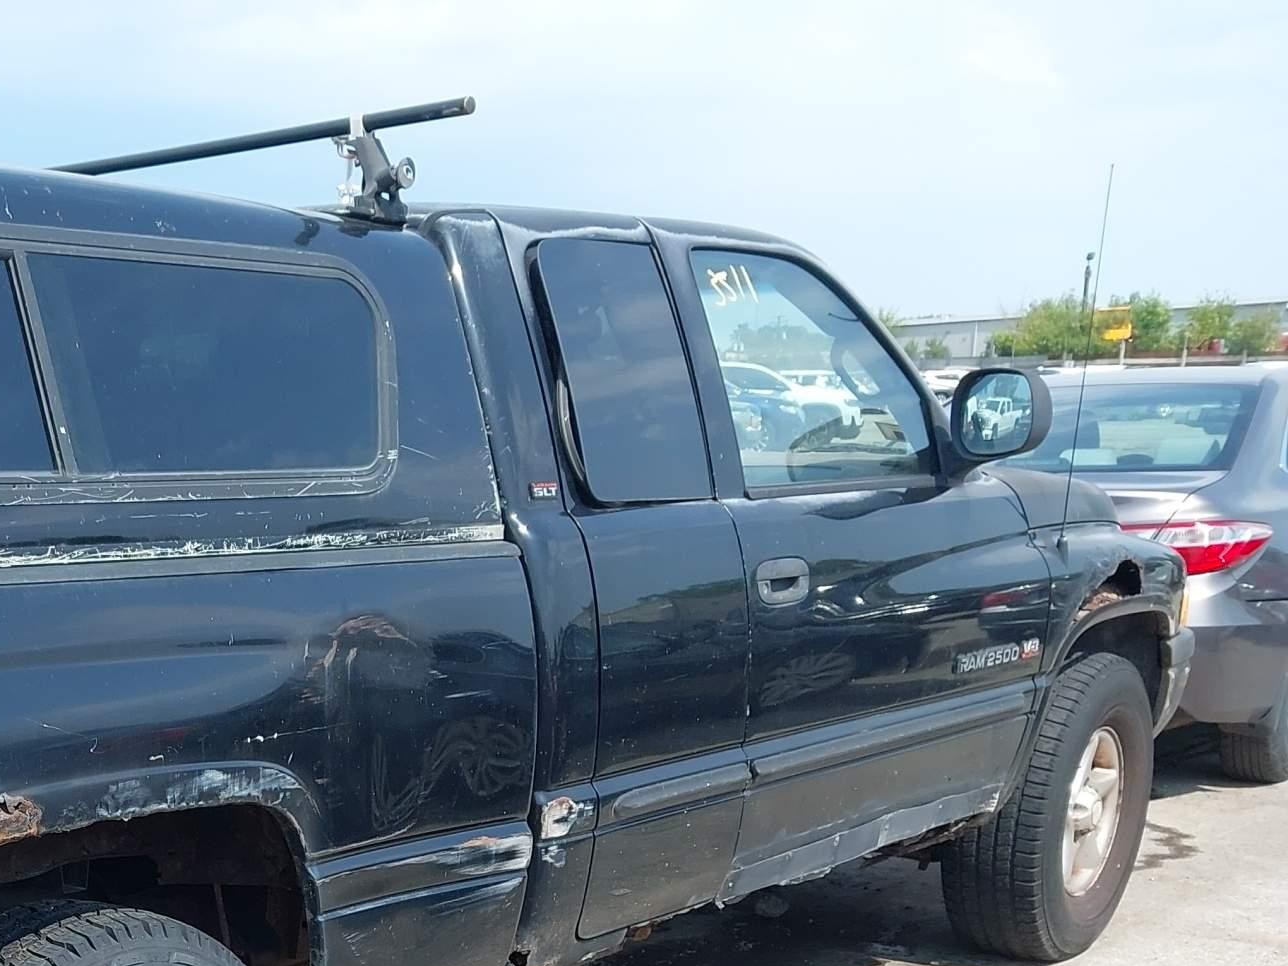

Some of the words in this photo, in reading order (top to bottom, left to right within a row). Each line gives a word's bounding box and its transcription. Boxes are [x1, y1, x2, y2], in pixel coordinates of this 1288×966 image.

[706, 264, 759, 306] 3511
[533, 487, 557, 497] SLT
[960, 654, 986, 673] RAM
[986, 646, 1020, 667] 2500
